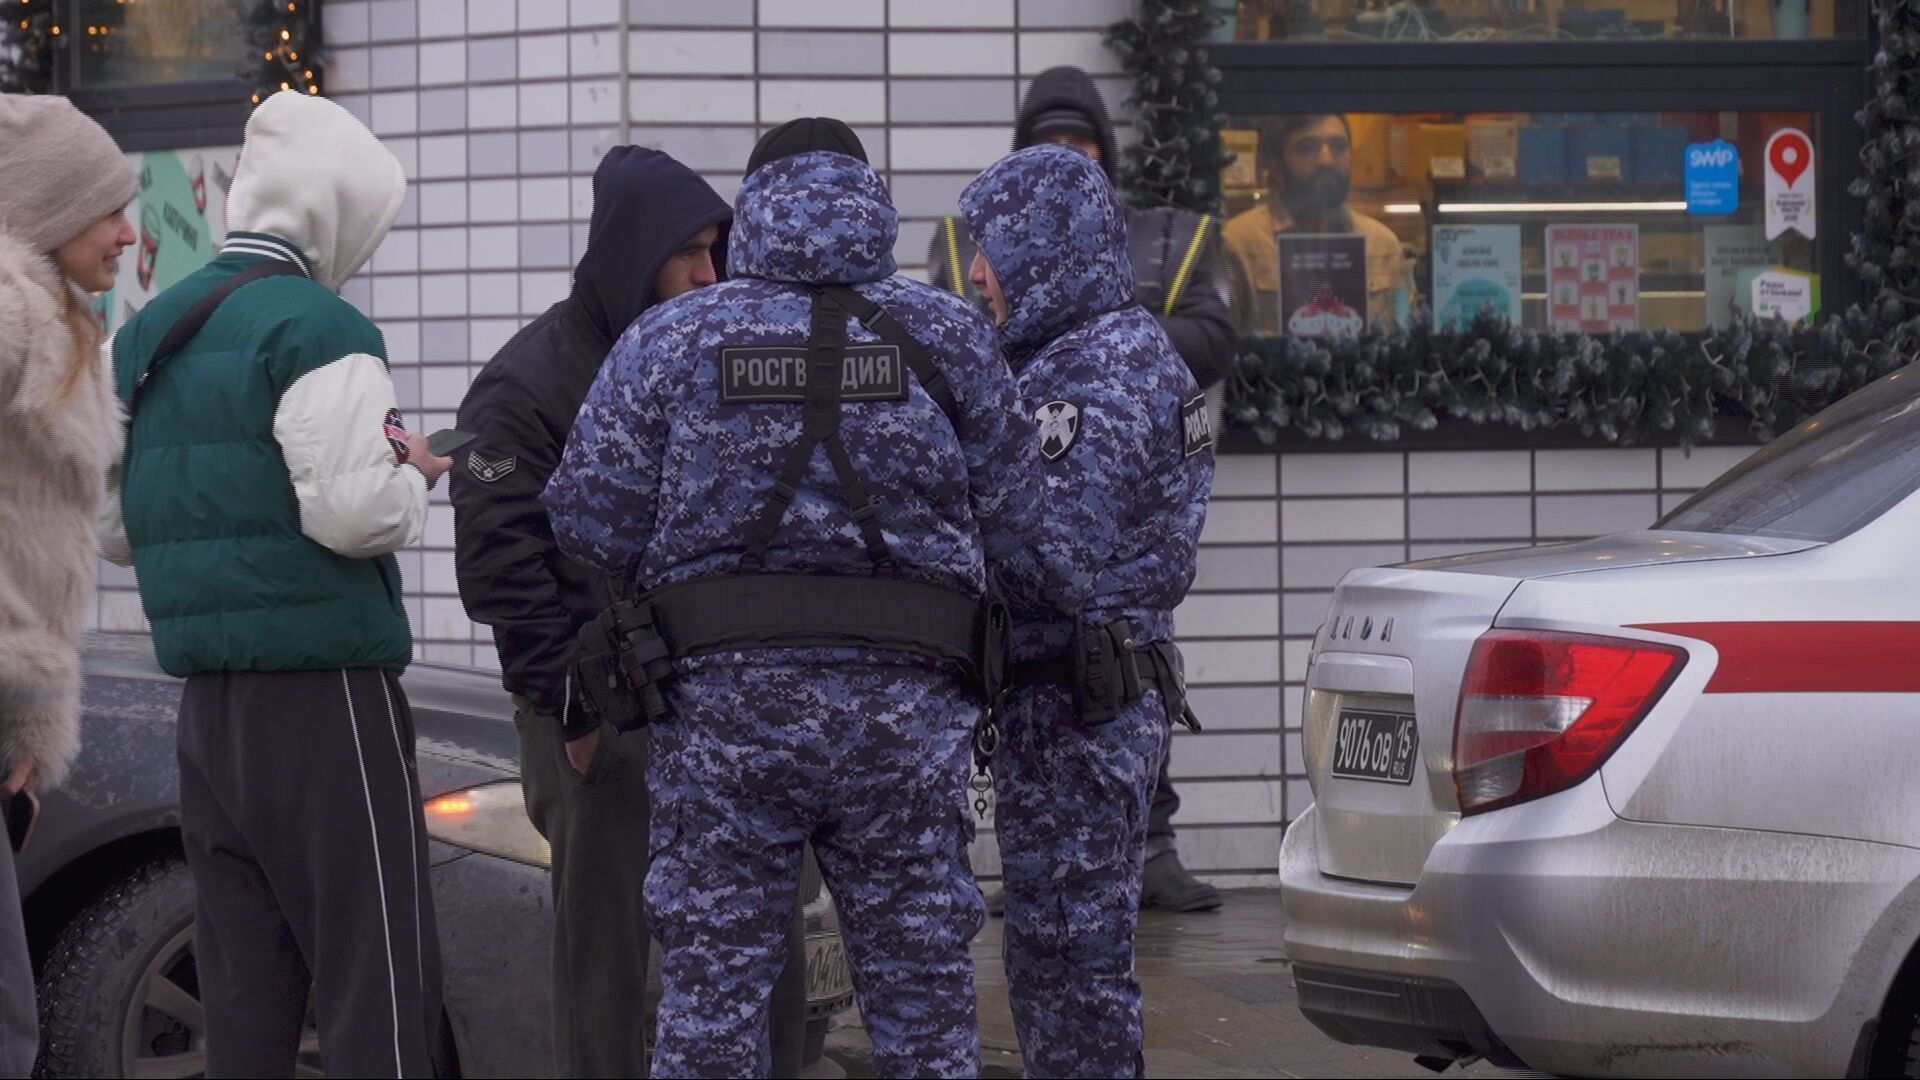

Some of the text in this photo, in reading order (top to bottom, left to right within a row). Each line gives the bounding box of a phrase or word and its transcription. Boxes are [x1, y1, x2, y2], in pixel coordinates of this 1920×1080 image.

[732, 355, 892, 390] РОСГВДИЯ
[1337, 718, 1373, 770] 9076
[1397, 720, 1414, 759] 15
